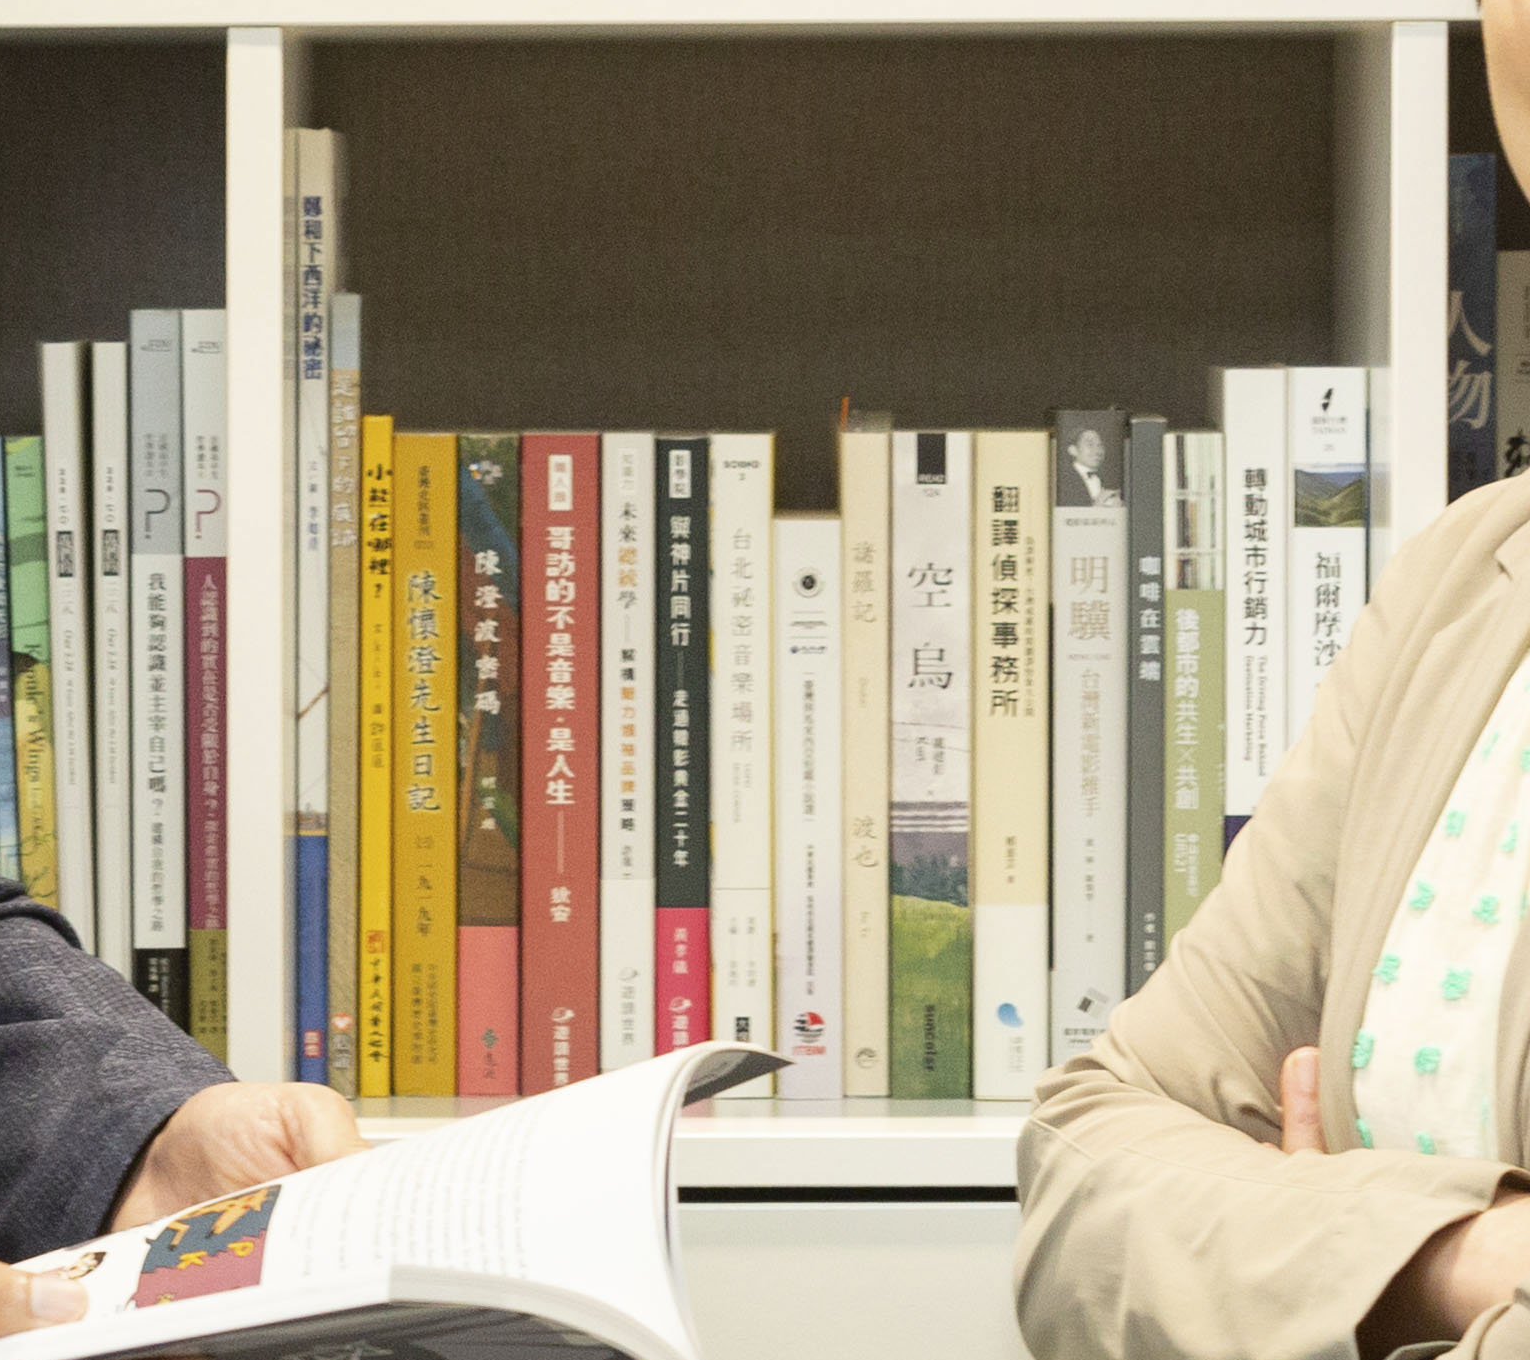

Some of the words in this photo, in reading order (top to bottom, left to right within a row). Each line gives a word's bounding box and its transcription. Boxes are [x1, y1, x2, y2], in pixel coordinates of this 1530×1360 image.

[669, 515, 691, 648] 與神片同行
[991, 485, 1020, 718] 翻譯偵探事務所
[1139, 555, 1161, 682] 咖啡在雲端
[1243, 467, 1269, 646] 轉動城市行銷力
[1313, 551, 1342, 668] 福爾摩沙
[406, 570, 442, 814] 陳懷澄先生日記
[473, 549, 504, 716] 陳澄波密碼
[906, 561, 956, 691] 空鳥
[24, 729, 48, 784] Wings
